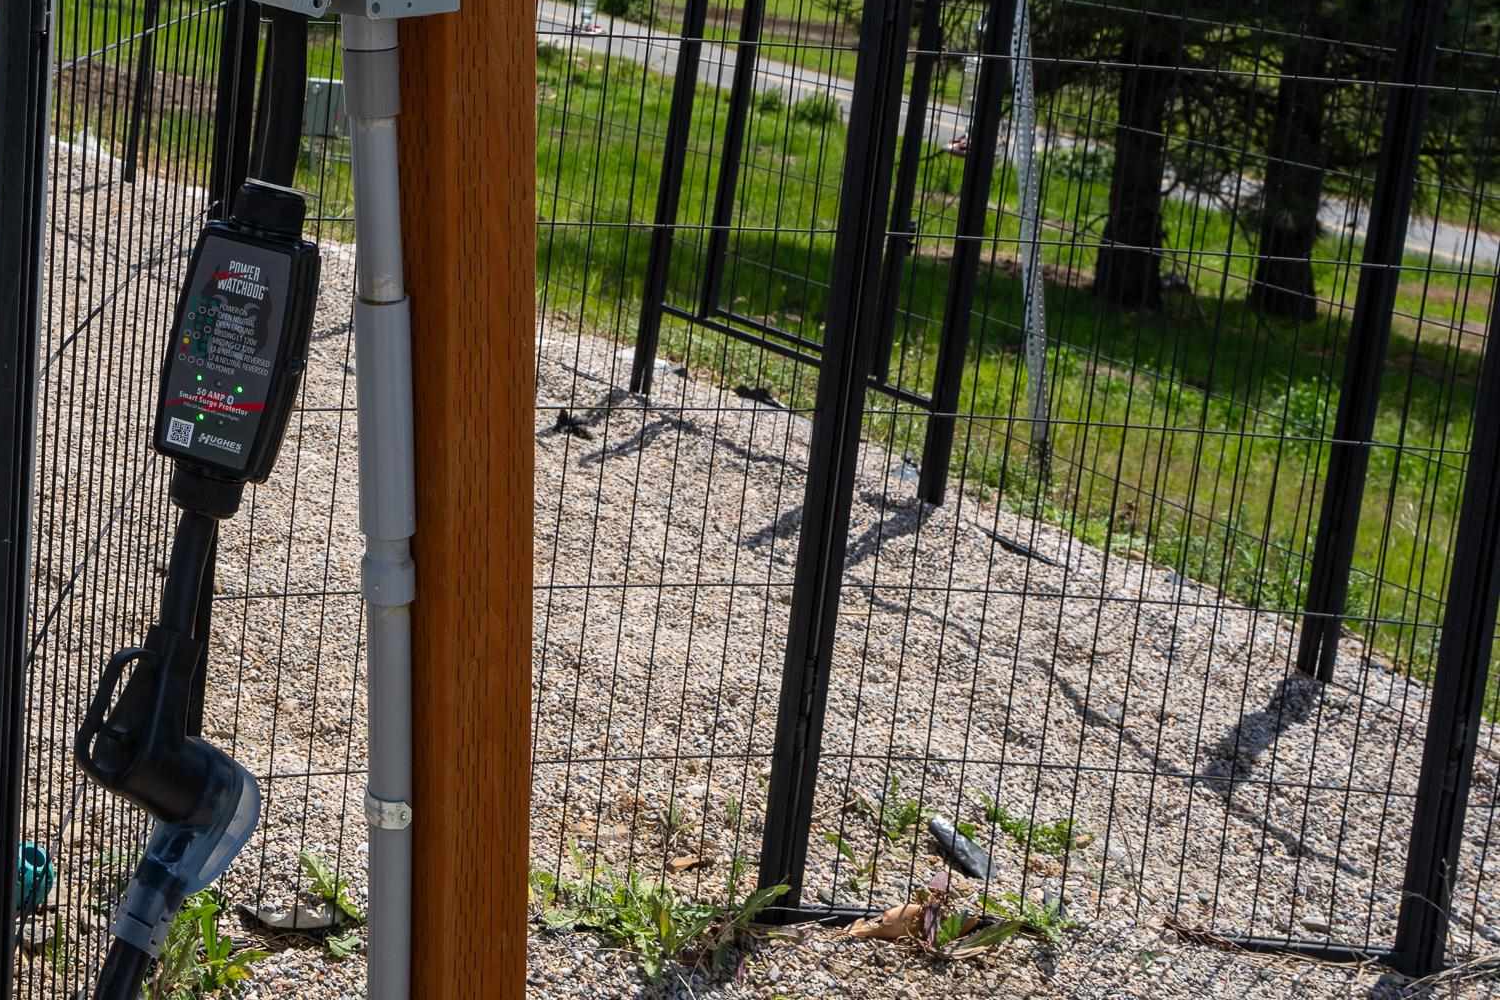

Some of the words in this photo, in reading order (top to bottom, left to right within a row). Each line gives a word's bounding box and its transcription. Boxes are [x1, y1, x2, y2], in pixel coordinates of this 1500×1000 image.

[229, 260, 261, 282] POWER
[179, 390, 198, 401] Smart
[199, 395, 218, 408] Surge
[218, 401, 248, 417] Protector
[207, 390, 226, 401] AMP
